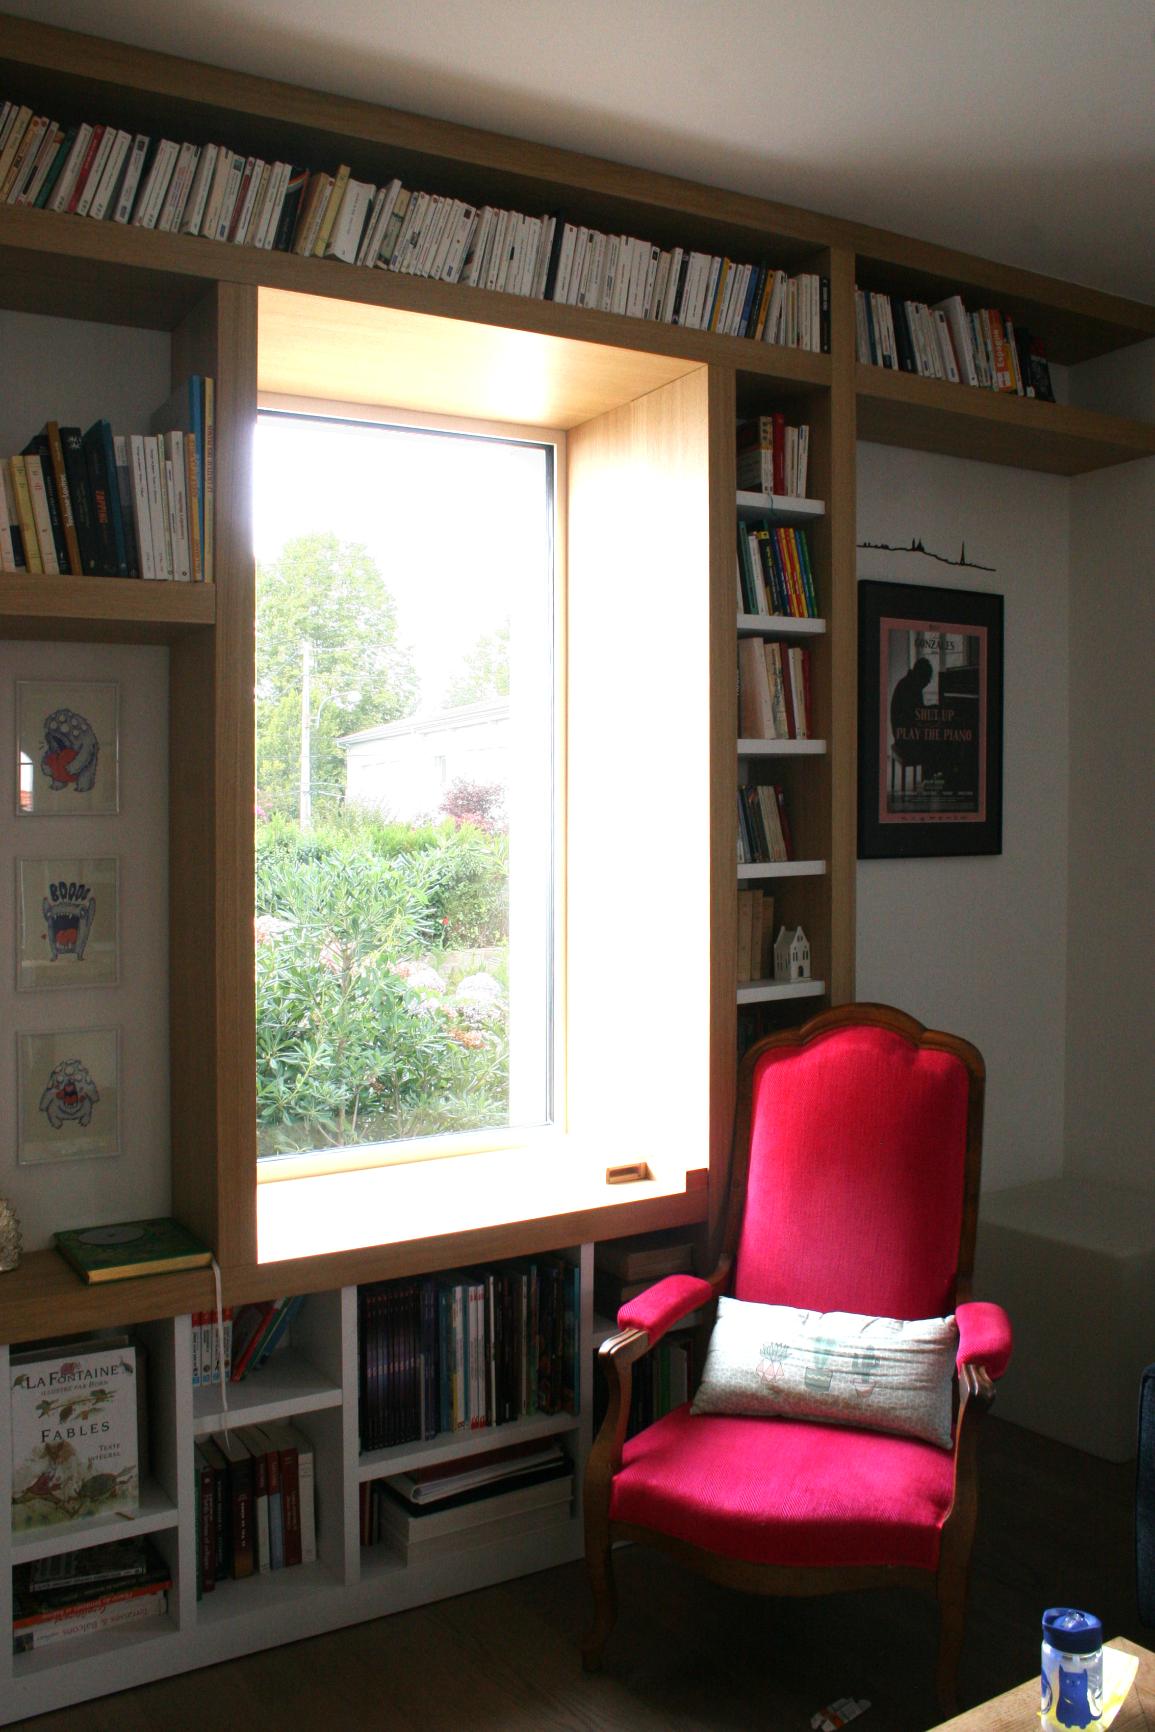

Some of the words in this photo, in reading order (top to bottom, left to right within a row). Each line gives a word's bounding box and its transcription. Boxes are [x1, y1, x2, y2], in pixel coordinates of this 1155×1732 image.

[914, 708, 938, 721] SHUT
[942, 709, 955, 722] UP
[895, 727, 920, 740] PLAY
[923, 728, 940, 741] THE
[943, 728, 973, 743] PIANO
[49, 1364, 119, 1386] FONTAINE
[41, 1421, 110, 1443] FABLES
